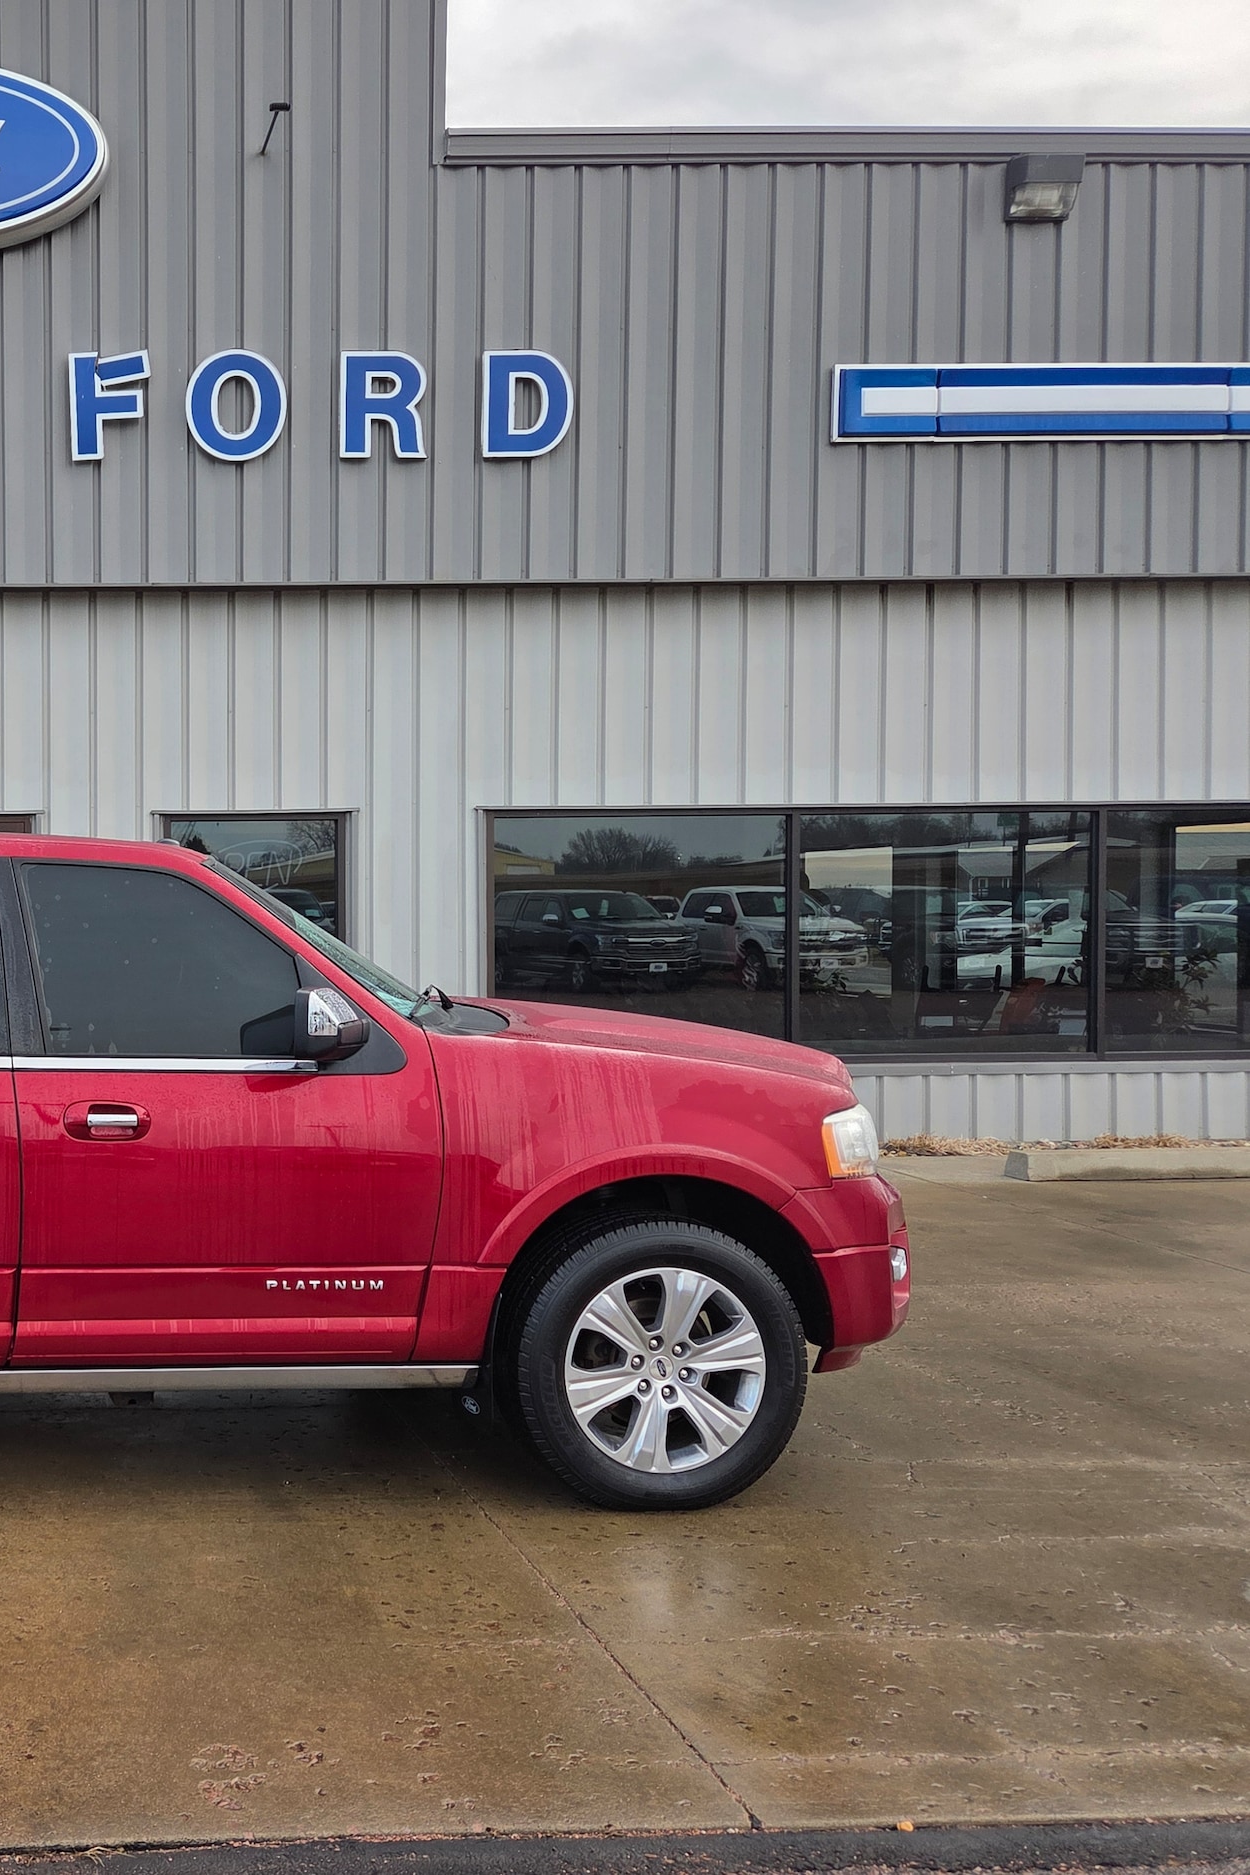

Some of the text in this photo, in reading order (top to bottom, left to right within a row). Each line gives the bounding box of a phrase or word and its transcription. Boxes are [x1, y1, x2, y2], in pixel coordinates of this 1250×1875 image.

[68, 349, 574, 461] FORD
[223, 850, 293, 887] PEN
[266, 1279, 385, 1290] PLATINUM
